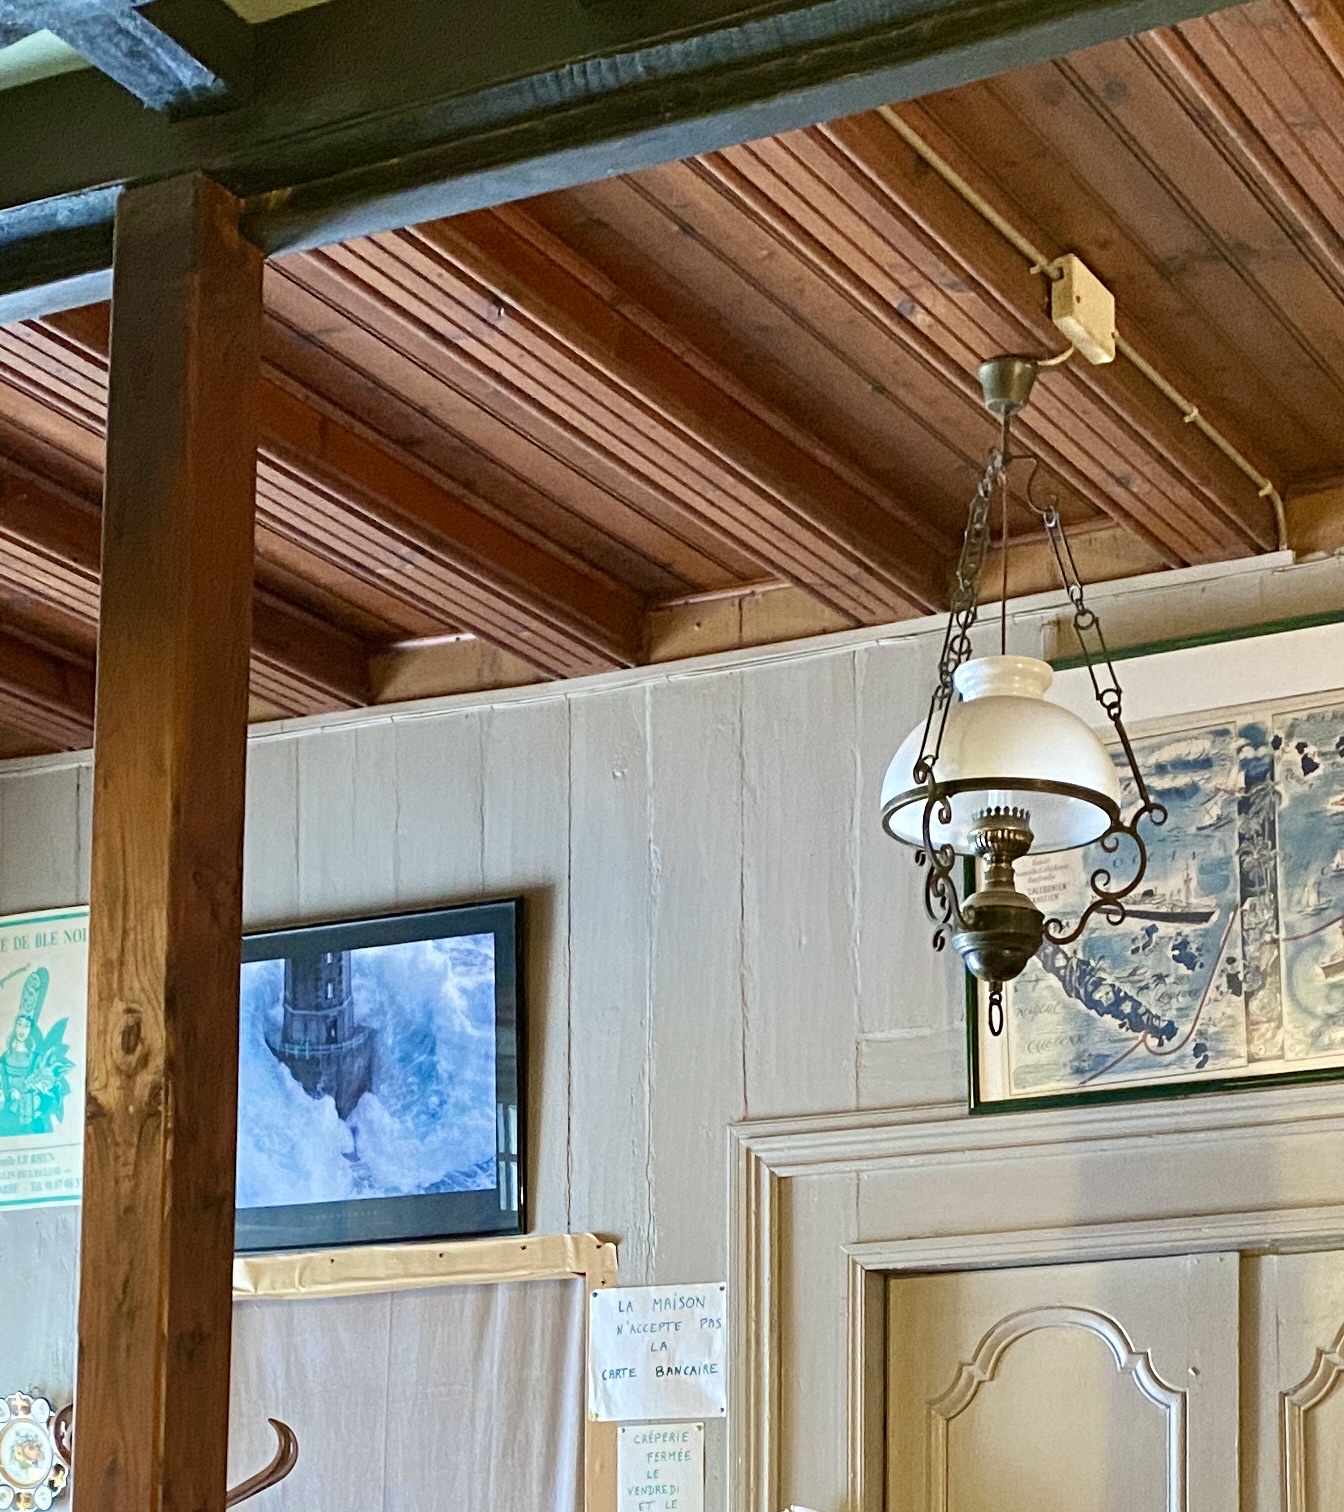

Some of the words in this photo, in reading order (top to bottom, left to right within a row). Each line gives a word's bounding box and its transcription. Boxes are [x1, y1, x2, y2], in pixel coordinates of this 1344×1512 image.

[13, 935, 30, 951] DE
[618, 1300, 634, 1314] LA
[616, 1320, 683, 1336] N'ACCEPTE
[699, 1317, 723, 1331] PAS
[650, 1340, 668, 1353] LA
[601, 1367, 638, 1382] CARTE
[646, 1447, 693, 1464] FERMÉE
[646, 1469, 660, 1480] LE
[627, 1483, 681, 1497] VENDREDI
[638, 1500, 656, 1512] ET
[664, 1499, 679, 1510] LE
